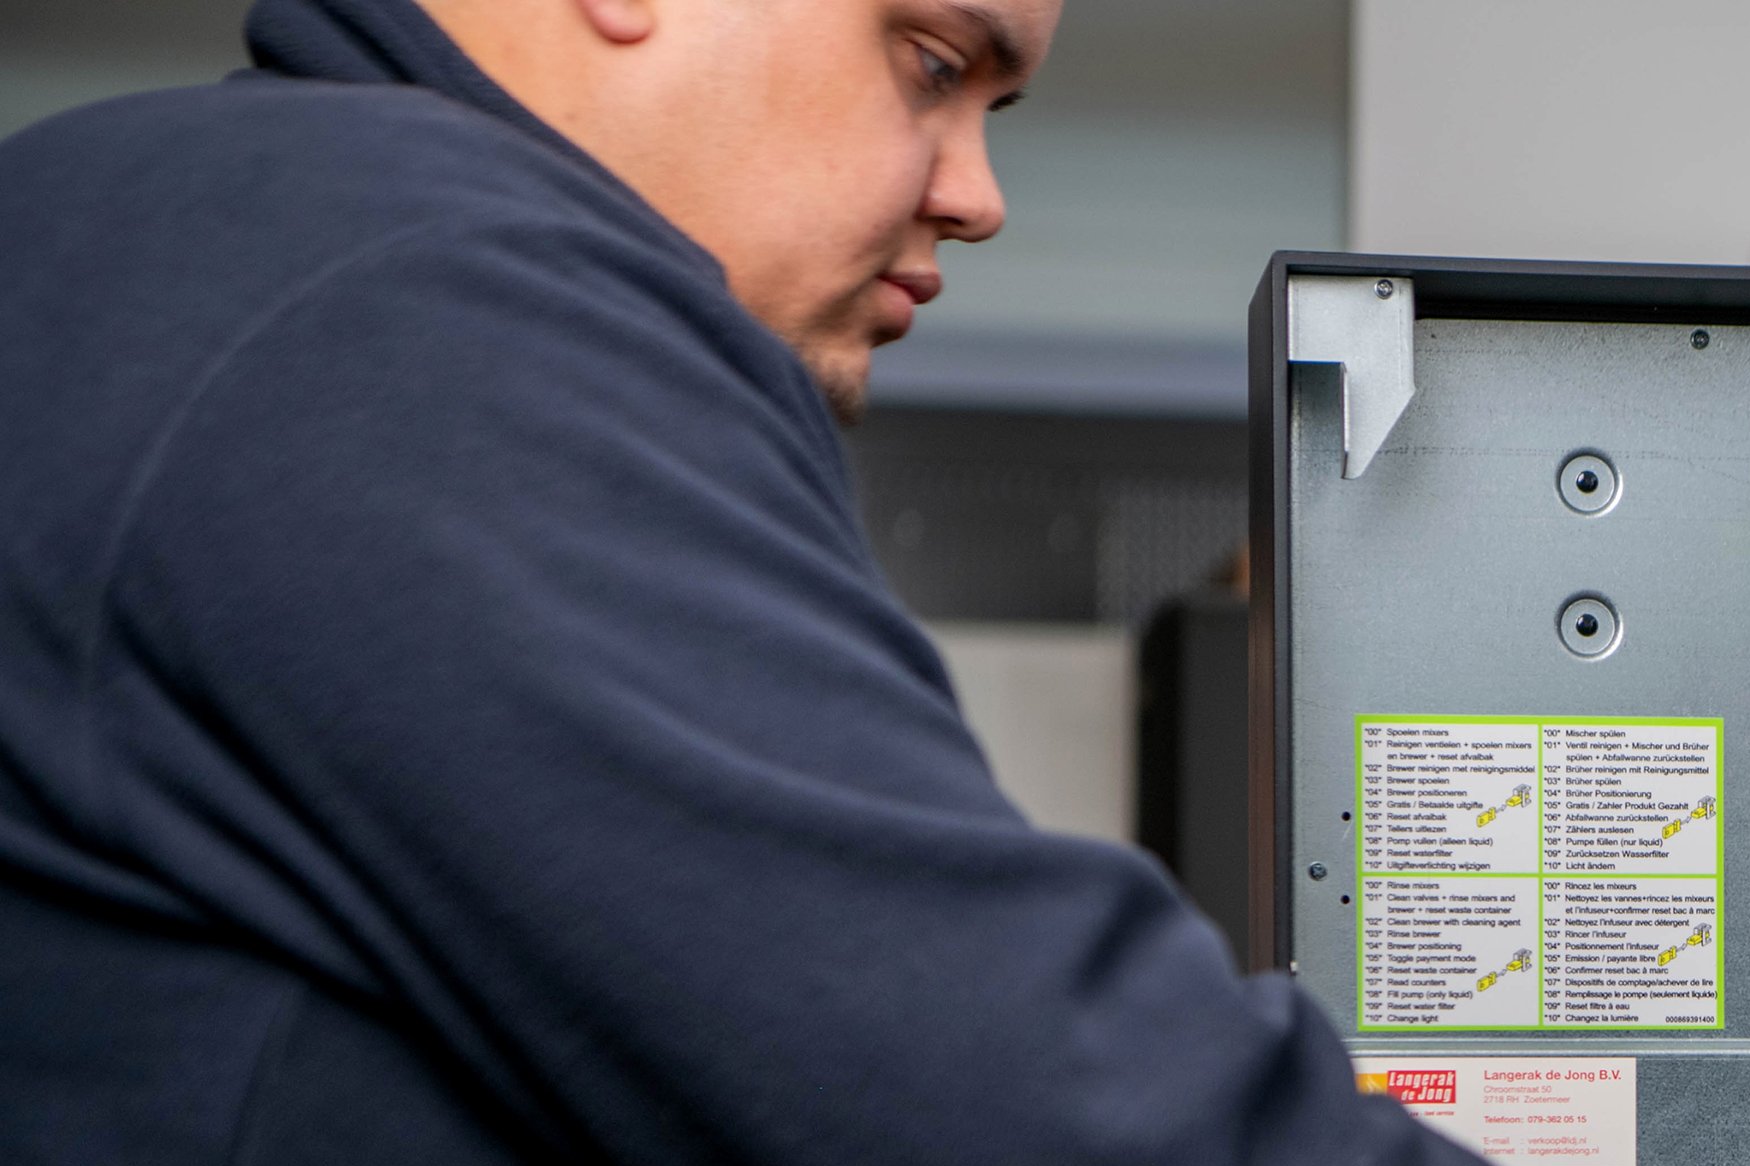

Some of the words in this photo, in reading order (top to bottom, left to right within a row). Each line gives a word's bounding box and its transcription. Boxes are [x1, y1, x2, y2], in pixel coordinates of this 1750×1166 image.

[1386, 740, 1422, 748] Reinigen
[1632, 742, 1663, 750] Mischer
[1644, 767, 1709, 775] Reinigungsmittel
[1595, 790, 1652, 798] Positionierung
[1625, 802, 1656, 810] Produkt
[1658, 802, 1689, 810] Gezahlt
[1386, 837, 1410, 845] Pomp
[1469, 838, 1493, 846] liquid)
[1566, 838, 1594, 846] Pumpe
[1597, 838, 1618, 846] füllen
[1639, 838, 1663, 847] liquid)
[1566, 850, 1620, 858] Zurücksetzen
[1566, 862, 1585, 870] Licht
[1387, 881, 1410, 889] Rinse
[1565, 882, 1591, 890] Rincez
[1565, 930, 1590, 938] Rincer
[1387, 954, 1414, 962] Toggle
[1387, 990, 1399, 998] Fill
[1565, 1002, 1588, 1010] Reset
[1590, 1002, 1606, 1010] filtre
[1387, 1015, 1419, 1023] Change
[1421, 1015, 1438, 1024] light
[1565, 1014, 1599, 1023] Changez
[1389, 1072, 1454, 1088] Langerak
[1484, 1070, 1542, 1082] Langerak
[1546, 1070, 1561, 1080] de
[1565, 1070, 1595, 1082] Jong
[1599, 1070, 1621, 1080] B.V.
[1401, 1089, 1415, 1101] de
[1417, 1087, 1452, 1102] Jong
[1528, 1147, 1599, 1156] langerakdejong.nl
